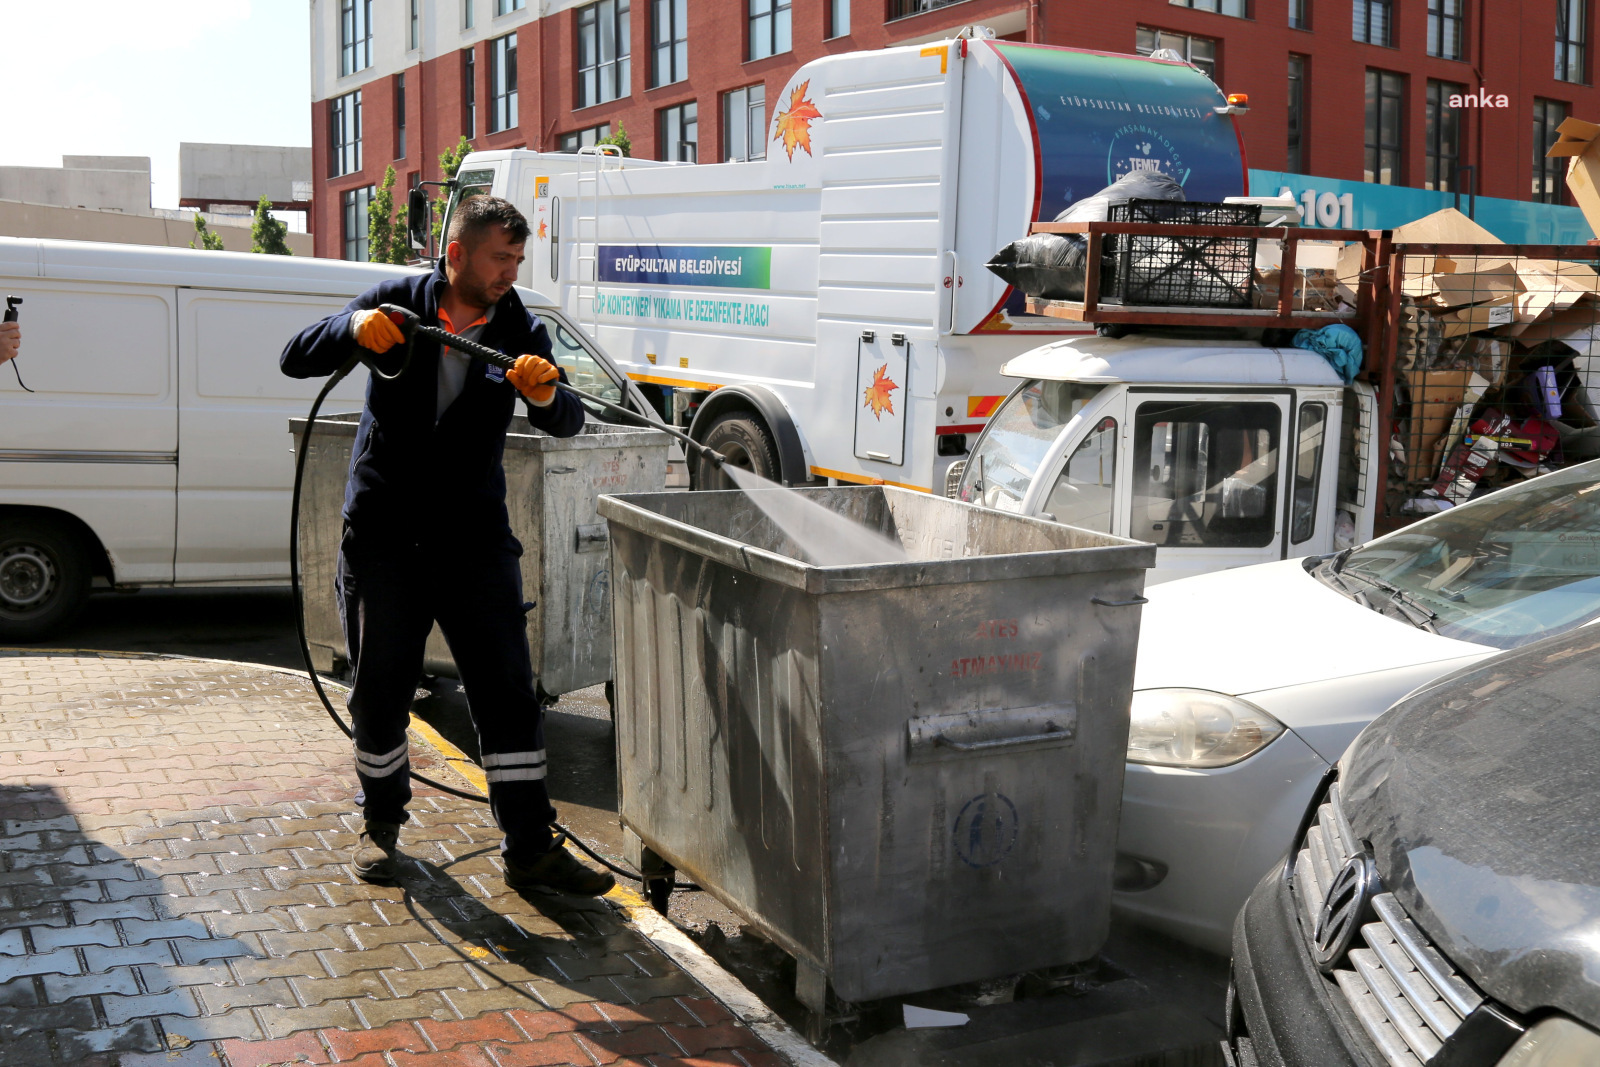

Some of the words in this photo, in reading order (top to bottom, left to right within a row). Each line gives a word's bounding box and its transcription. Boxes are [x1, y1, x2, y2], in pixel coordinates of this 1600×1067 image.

[1060, 95, 1131, 112] EYÜPSULTAN
[1137, 103, 1201, 118] BELEDİYESİ
[615, 254, 677, 274] EYÜPSULTAN
[679, 255, 742, 276] BELEDİYESİ
[607, 294, 652, 318] KONTEYNERİ
[653, 297, 682, 320] YIKAMA
[683, 299, 694, 320] VE
[695, 299, 742, 325] DEZENFEKTE
[743, 303, 769, 327] ARACI
[976, 618, 1018, 641] ATEŞ
[949, 652, 1043, 677] ATMAYINIZ
